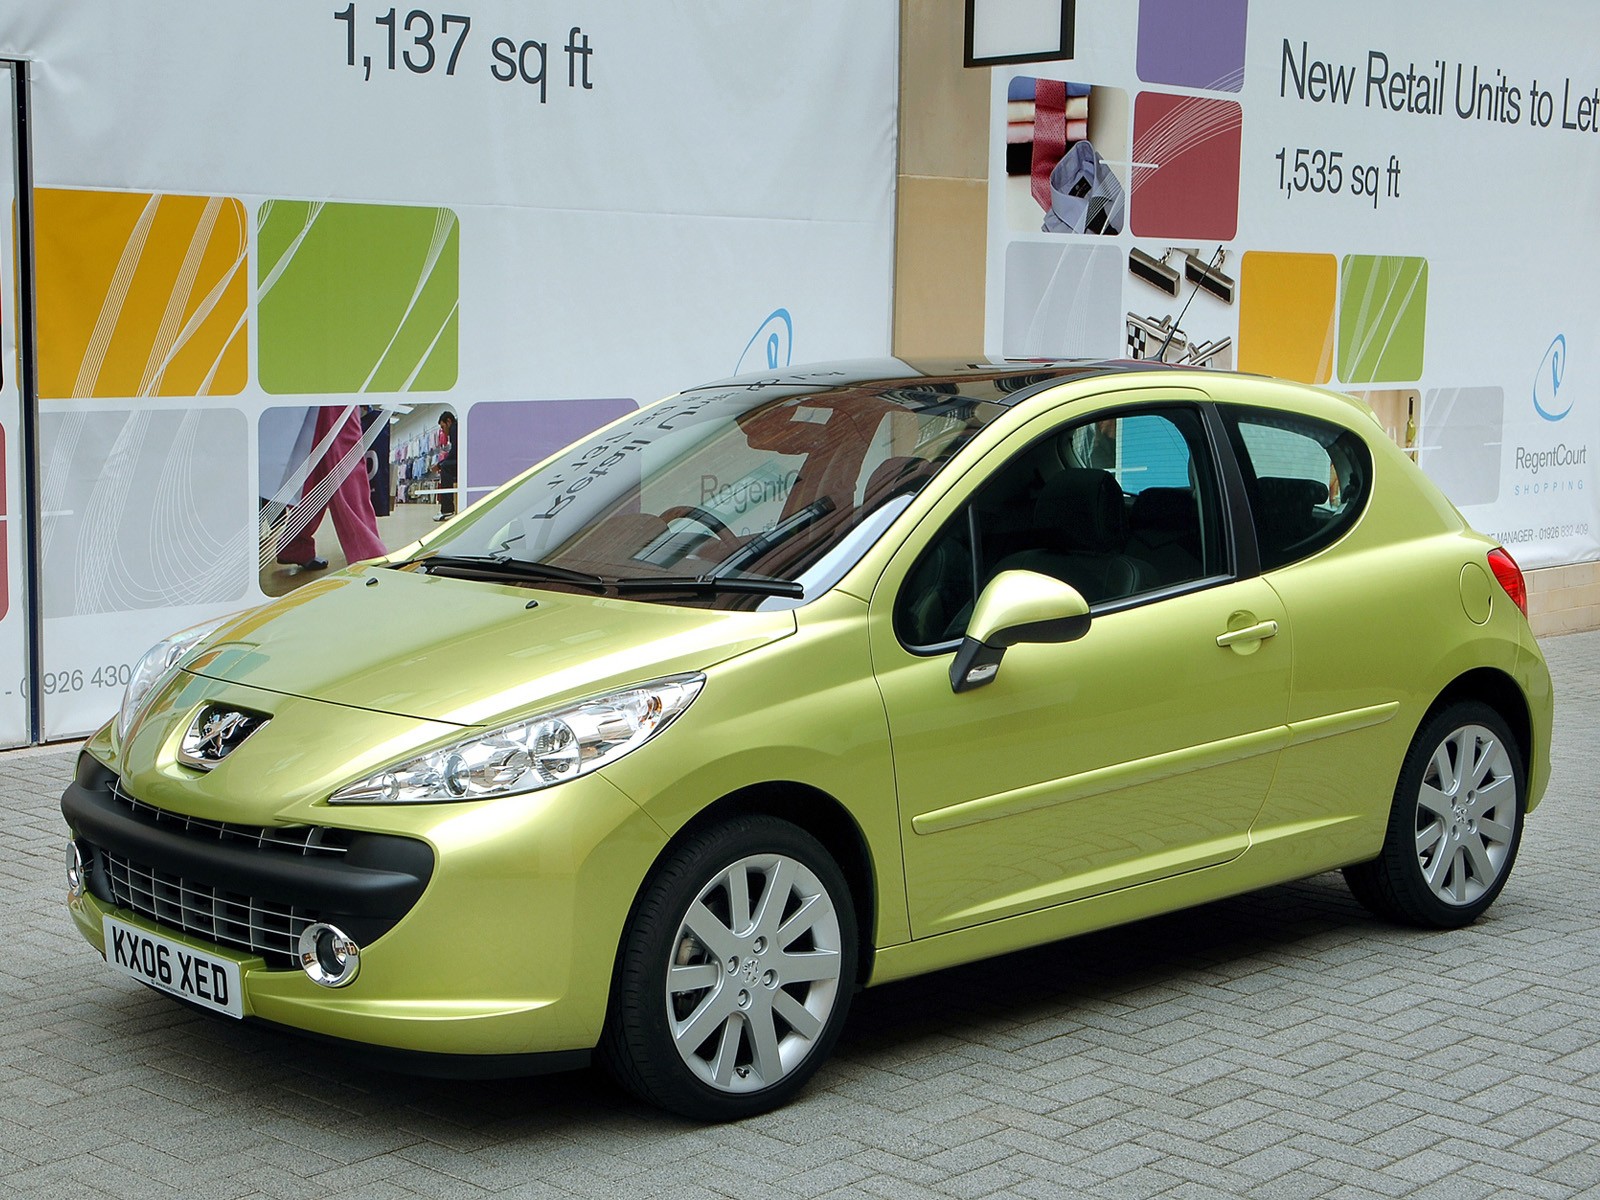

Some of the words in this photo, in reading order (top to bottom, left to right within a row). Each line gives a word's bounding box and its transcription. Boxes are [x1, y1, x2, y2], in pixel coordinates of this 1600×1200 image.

[334, 3, 471, 81] 1,137
[490, 37, 547, 103] sq
[564, 27, 593, 89] ft
[1280, 38, 1356, 105] New
[1365, 50, 1446, 115] Retail
[1455, 63, 1521, 125] Units
[1530, 80, 1553, 127] to
[1562, 78, 1600, 132] Let
[1275, 147, 1343, 199] 1,535
[1351, 165, 1379, 209] sq
[1387, 155, 1401, 197] ft
[1514, 480, 1584, 496] SHOPPING
[1515, 443, 1587, 474] RegentCourt
[1498, 529, 1534, 544] MANAGER
[1539, 526, 1560, 540] 01926
[111, 926, 173, 985] KX06
[177, 951, 229, 1006] XED
